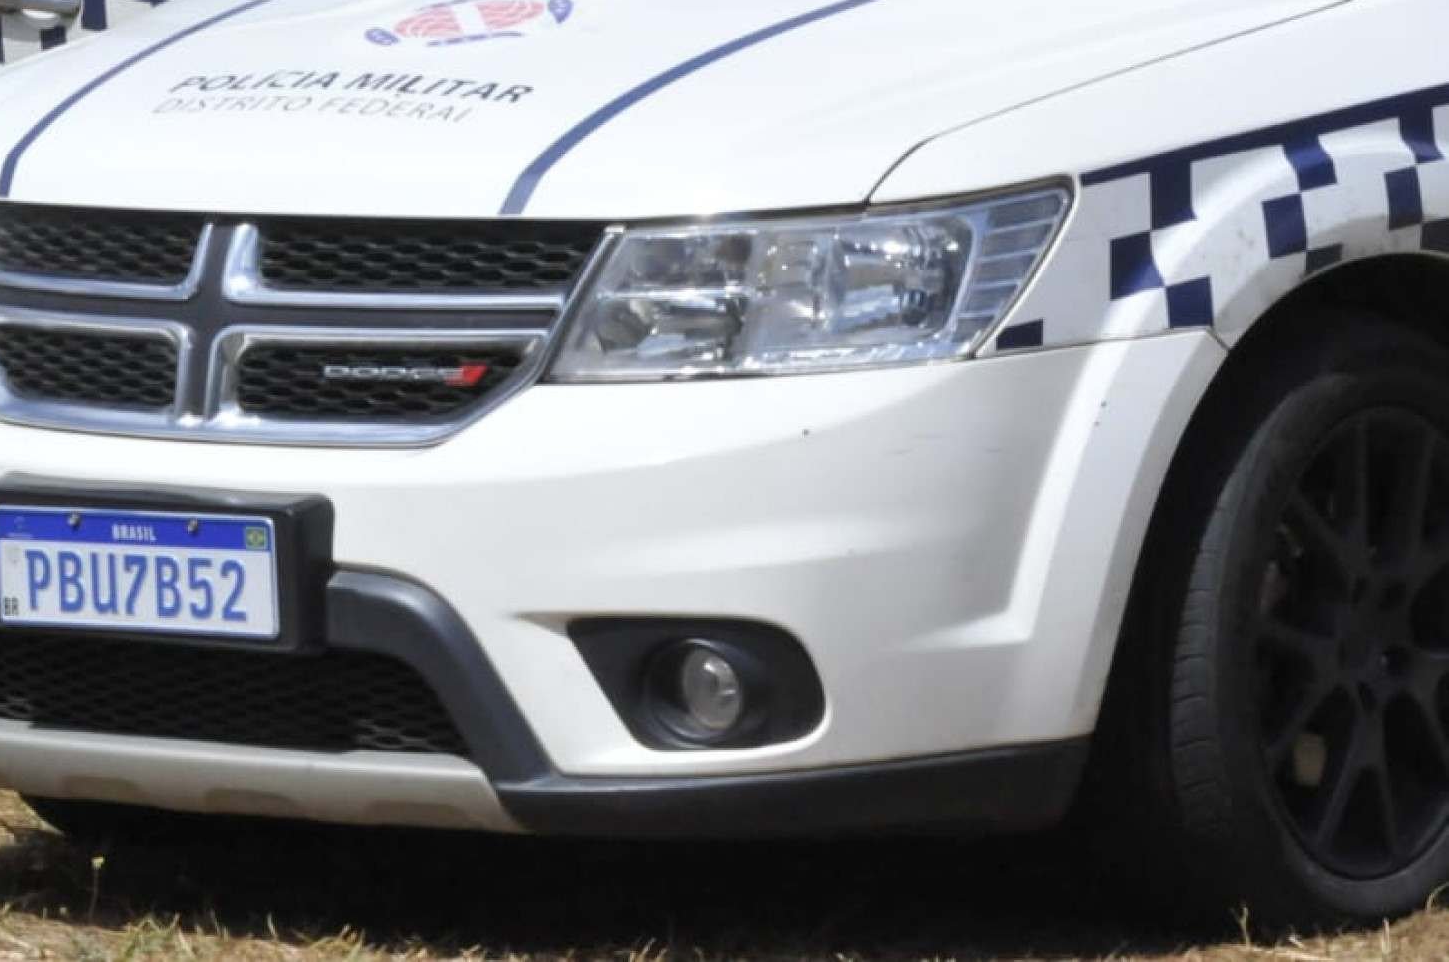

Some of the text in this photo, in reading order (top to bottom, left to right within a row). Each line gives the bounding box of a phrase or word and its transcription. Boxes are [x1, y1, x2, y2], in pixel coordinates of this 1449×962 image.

[167, 69, 535, 103] POLÍCIA MILITAR
[152, 95, 313, 114] DISTRITO
[324, 365, 464, 383] DODGE
[112, 524, 157, 542] BRASIL
[24, 549, 247, 622] PBU7B52
[4, 596, 20, 616] BR
